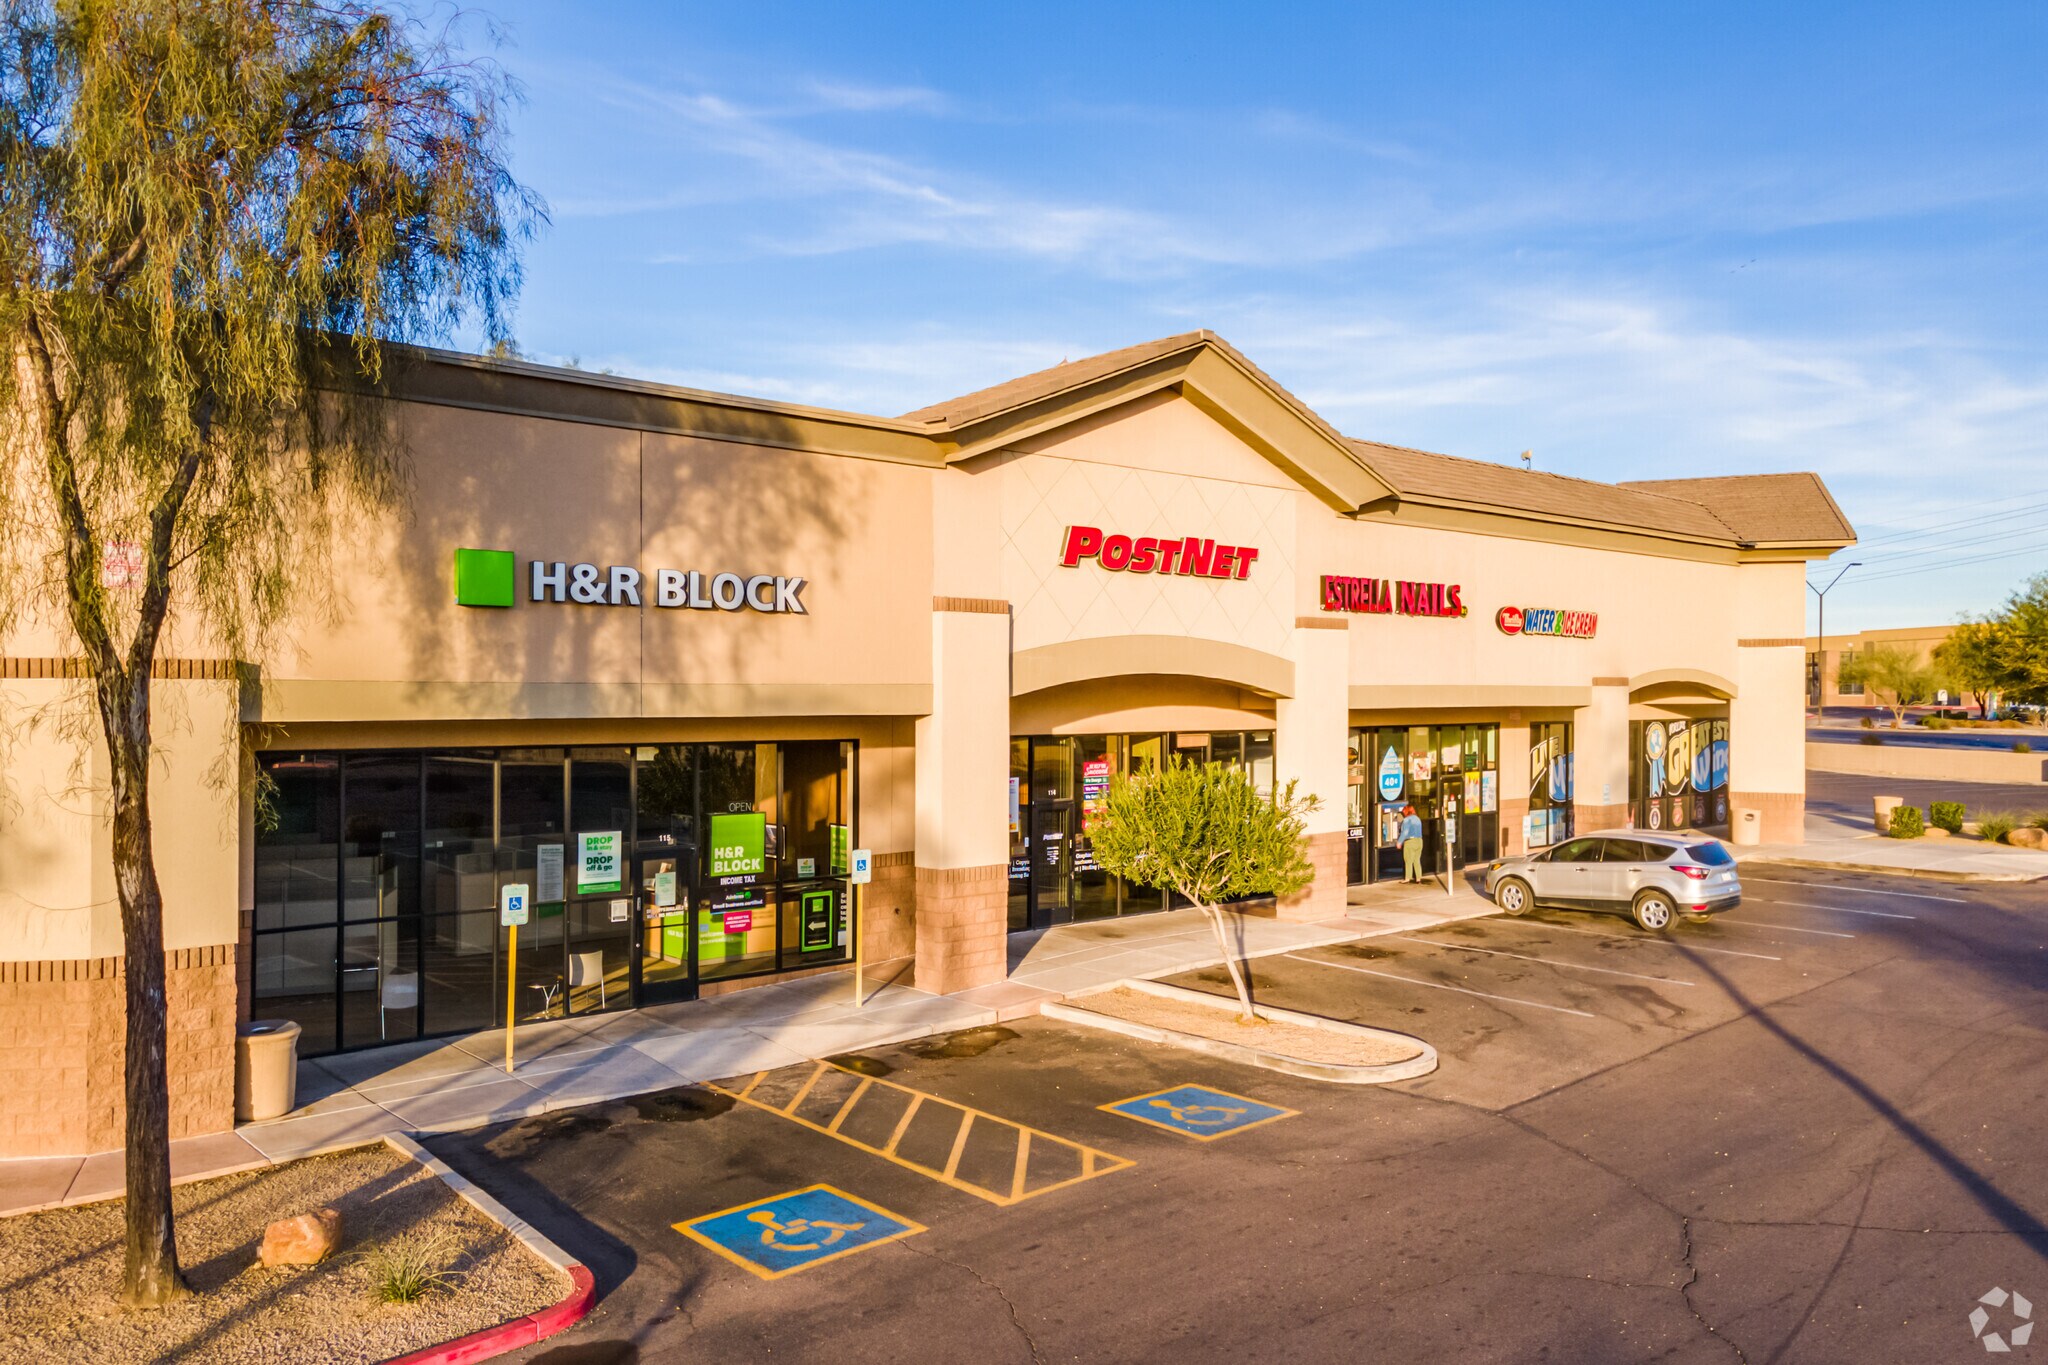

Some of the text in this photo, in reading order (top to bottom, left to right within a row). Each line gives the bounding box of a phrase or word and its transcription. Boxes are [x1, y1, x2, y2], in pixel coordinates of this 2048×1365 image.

[529, 560, 805, 613] H&R BLOCK
[1320, 575, 1462, 618] ESTRELLA NAILS
[1524, 608, 1598, 637] WATER & ICE CREAM
[728, 802, 752, 812] OPEN
[586, 836, 614, 845] DROP
[714, 846, 744, 859] H&R
[586, 856, 614, 865] DROP
[714, 859, 761, 873] BLOCK
[720, 875, 756, 886] INCOME TAX
